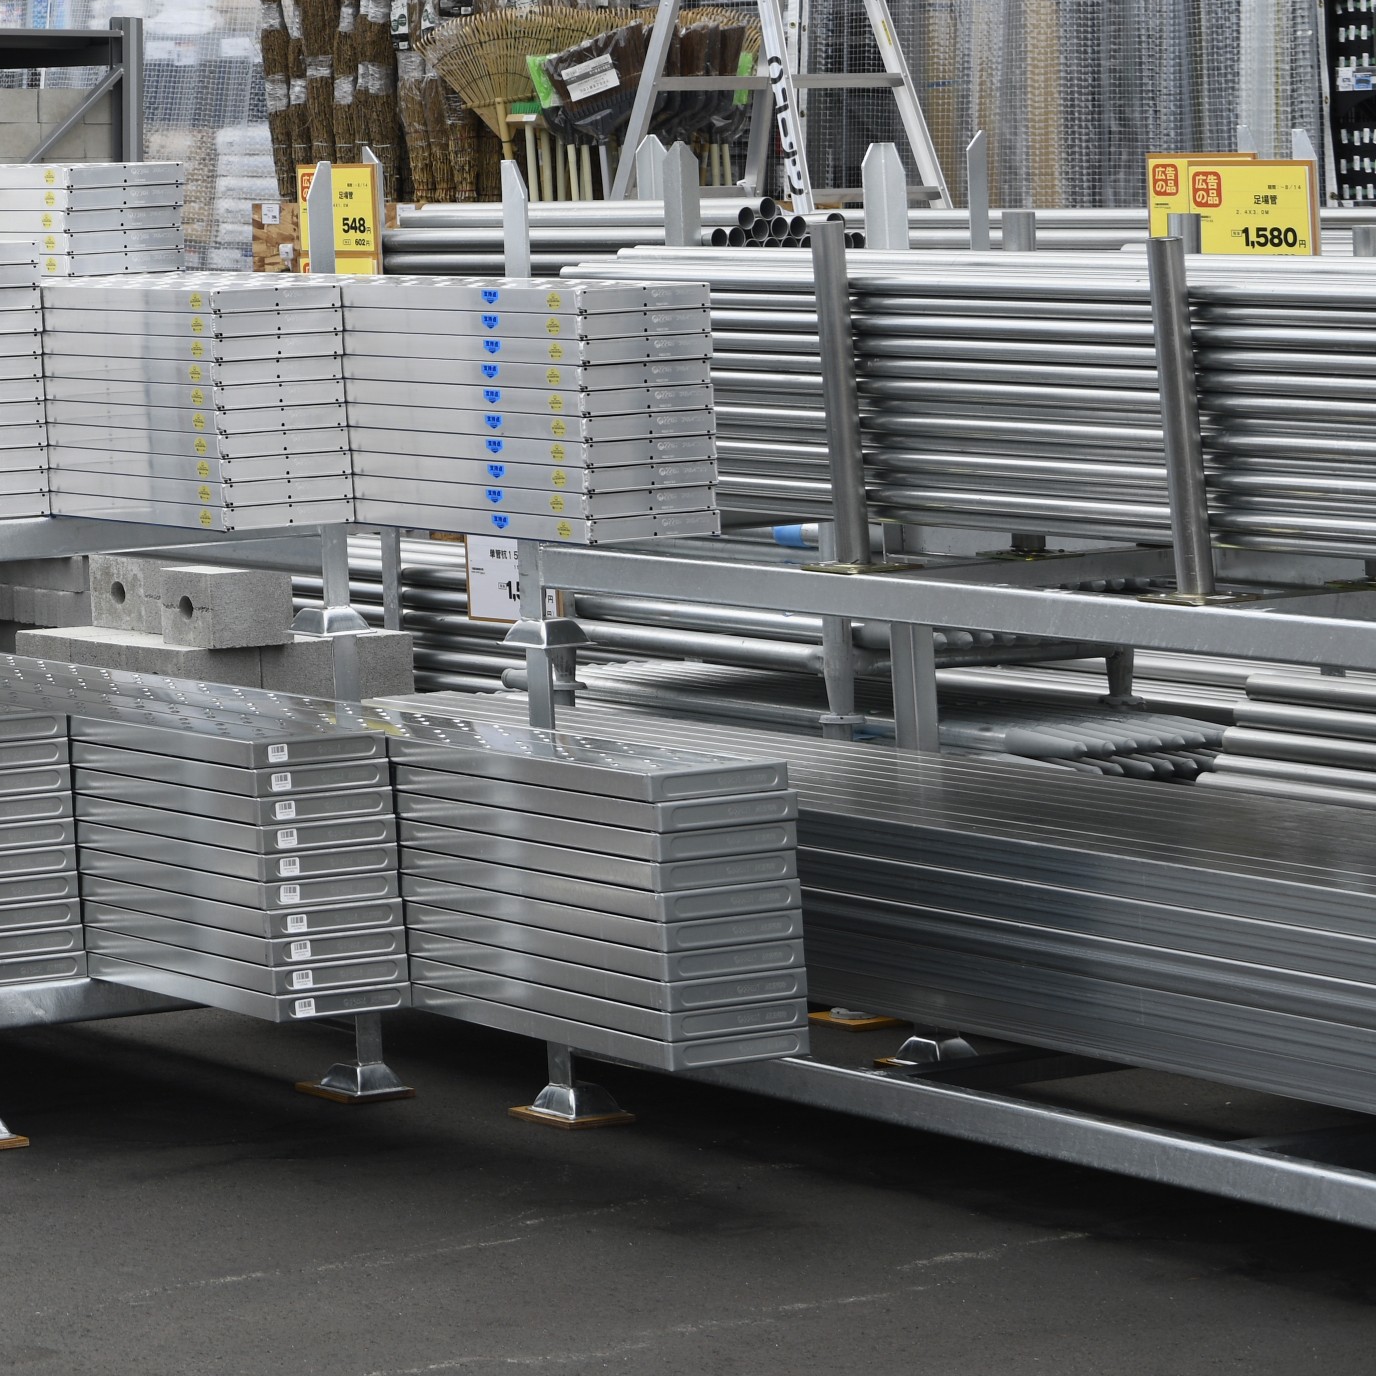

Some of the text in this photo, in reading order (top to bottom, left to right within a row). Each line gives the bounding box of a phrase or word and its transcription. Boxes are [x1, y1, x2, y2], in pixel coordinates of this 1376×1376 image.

[1155, 167, 1176, 180] 広告
[1155, 181, 1177, 193] の品
[1195, 174, 1219, 190] 広告
[1196, 190, 1220, 204] の品
